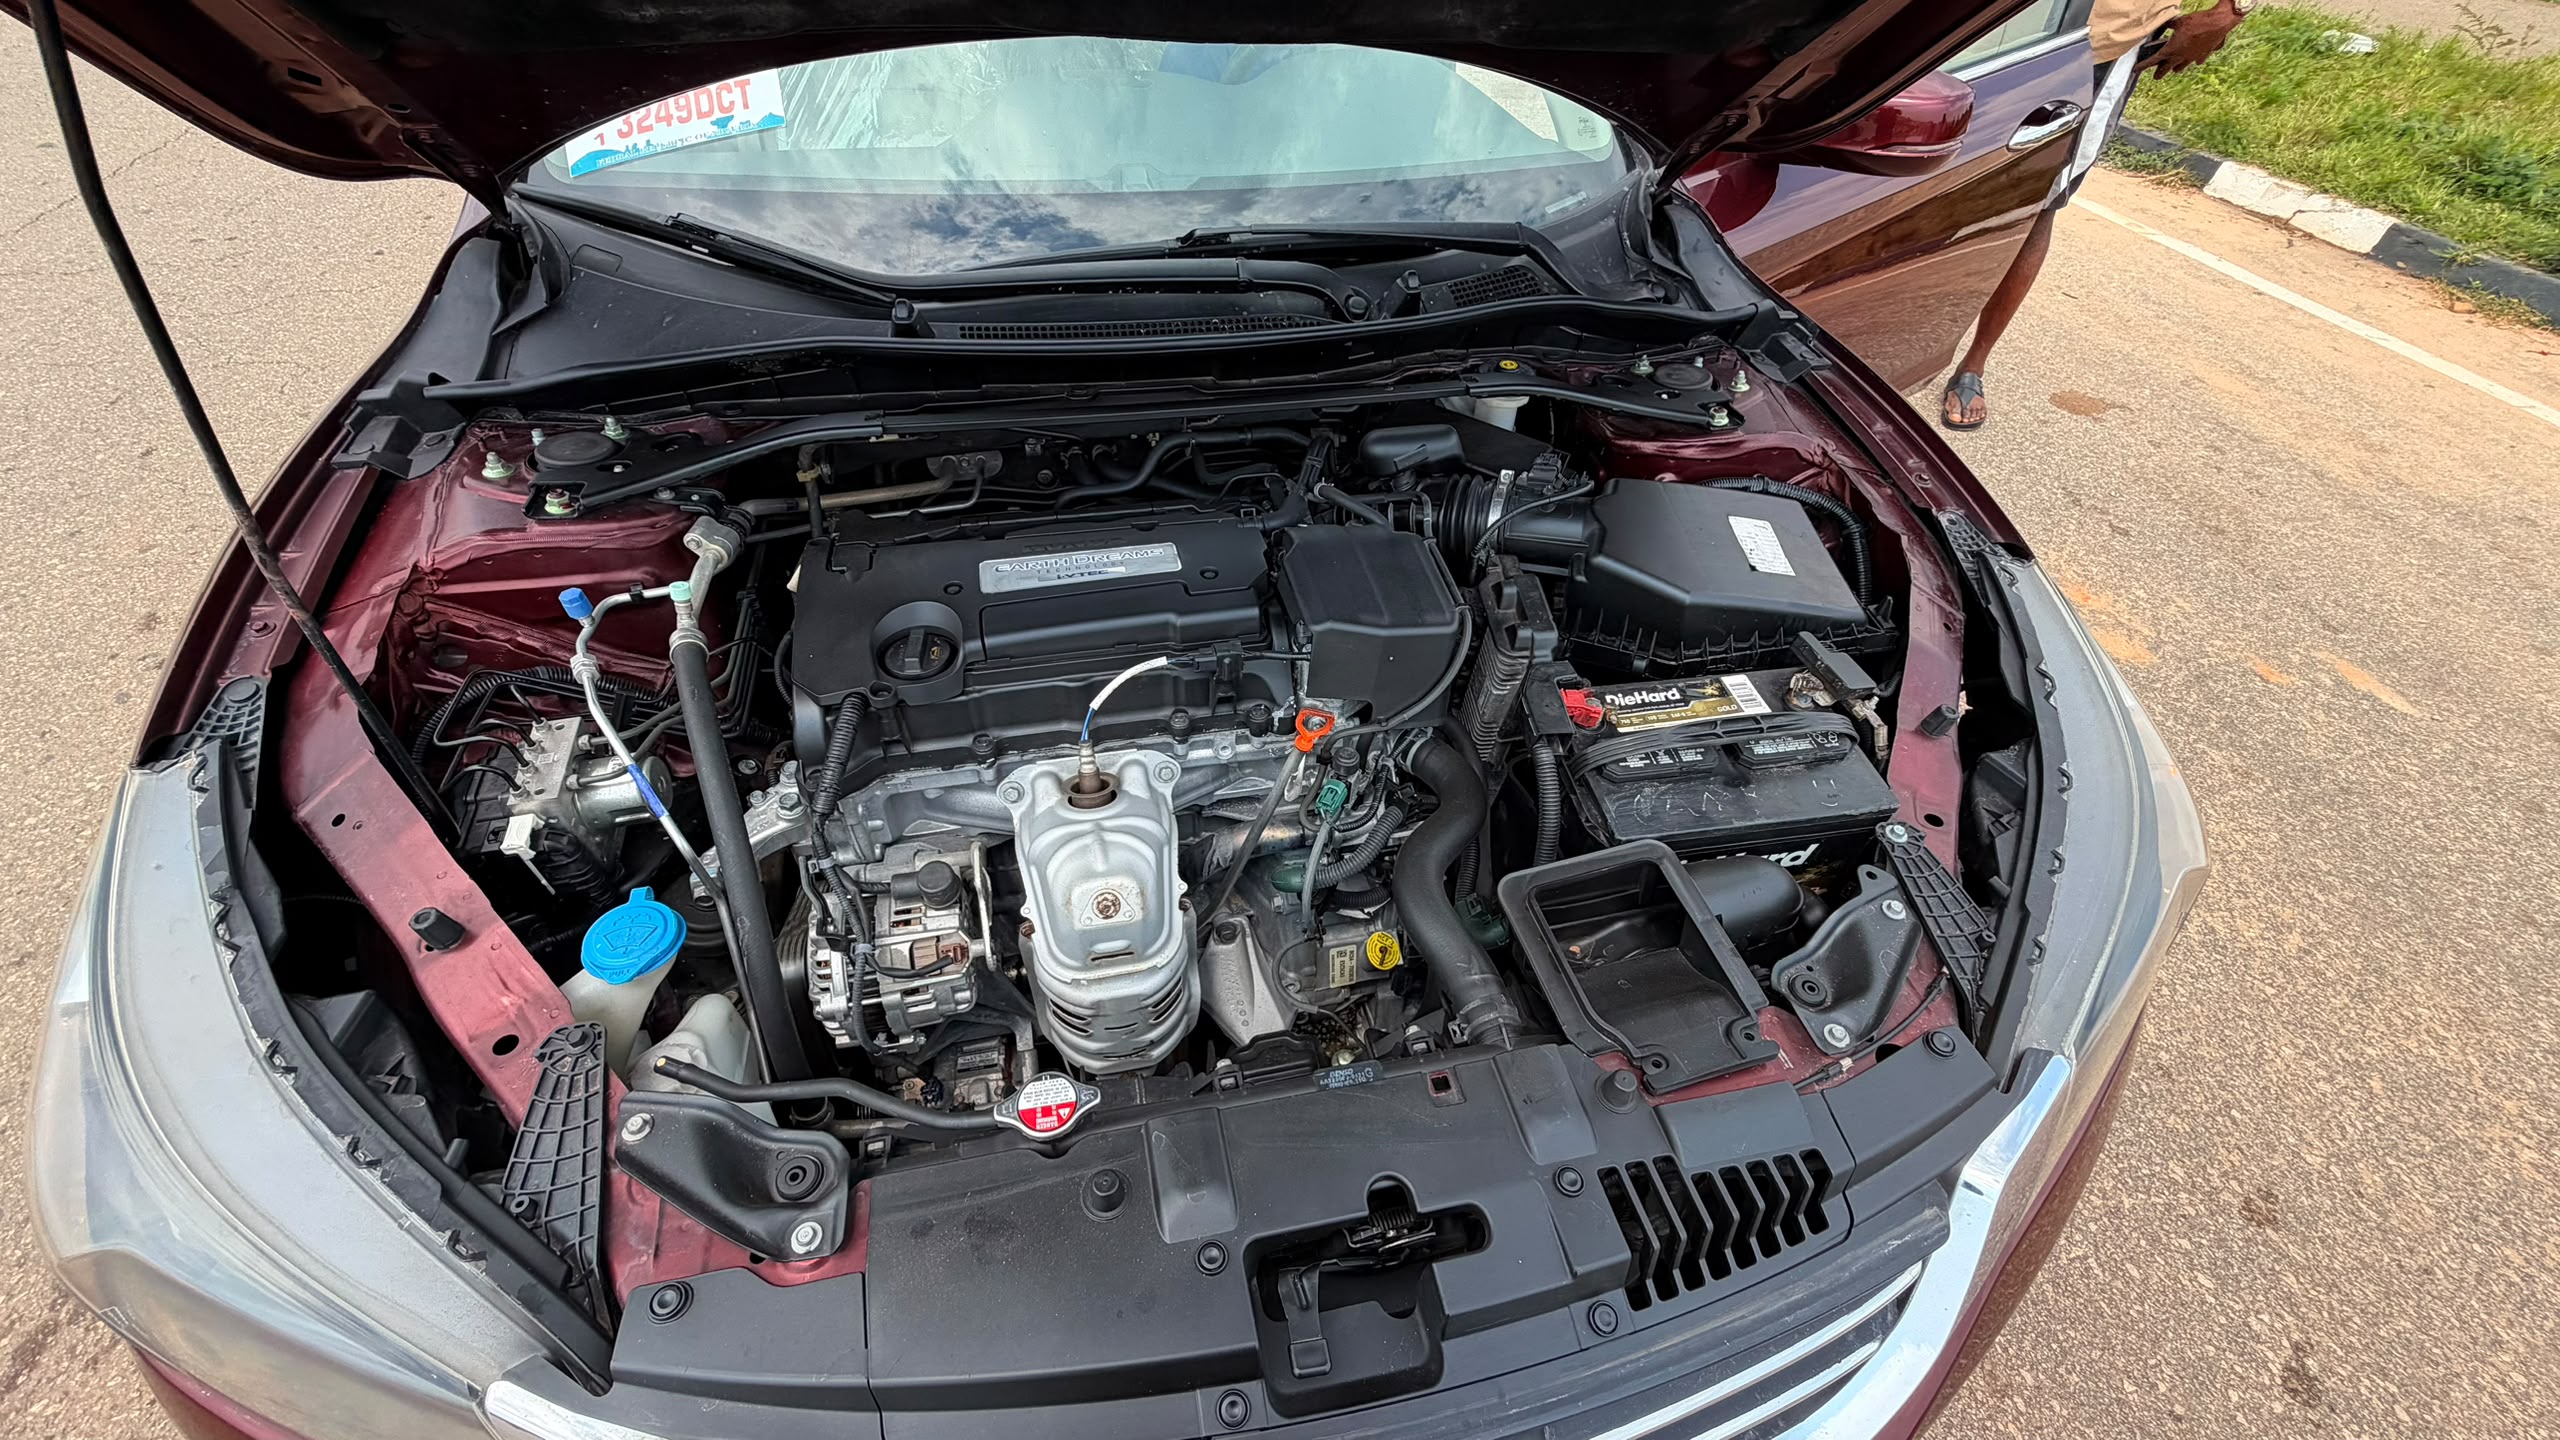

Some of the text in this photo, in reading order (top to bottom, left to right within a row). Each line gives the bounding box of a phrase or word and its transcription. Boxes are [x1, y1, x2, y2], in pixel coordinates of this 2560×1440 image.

[993, 548, 1165, 573] EARTH DREAMS
[1037, 561, 1125, 575] TECHNOLOGY
[1605, 687, 1682, 707] DieHard
[1716, 703, 1738, 713] GOLD
